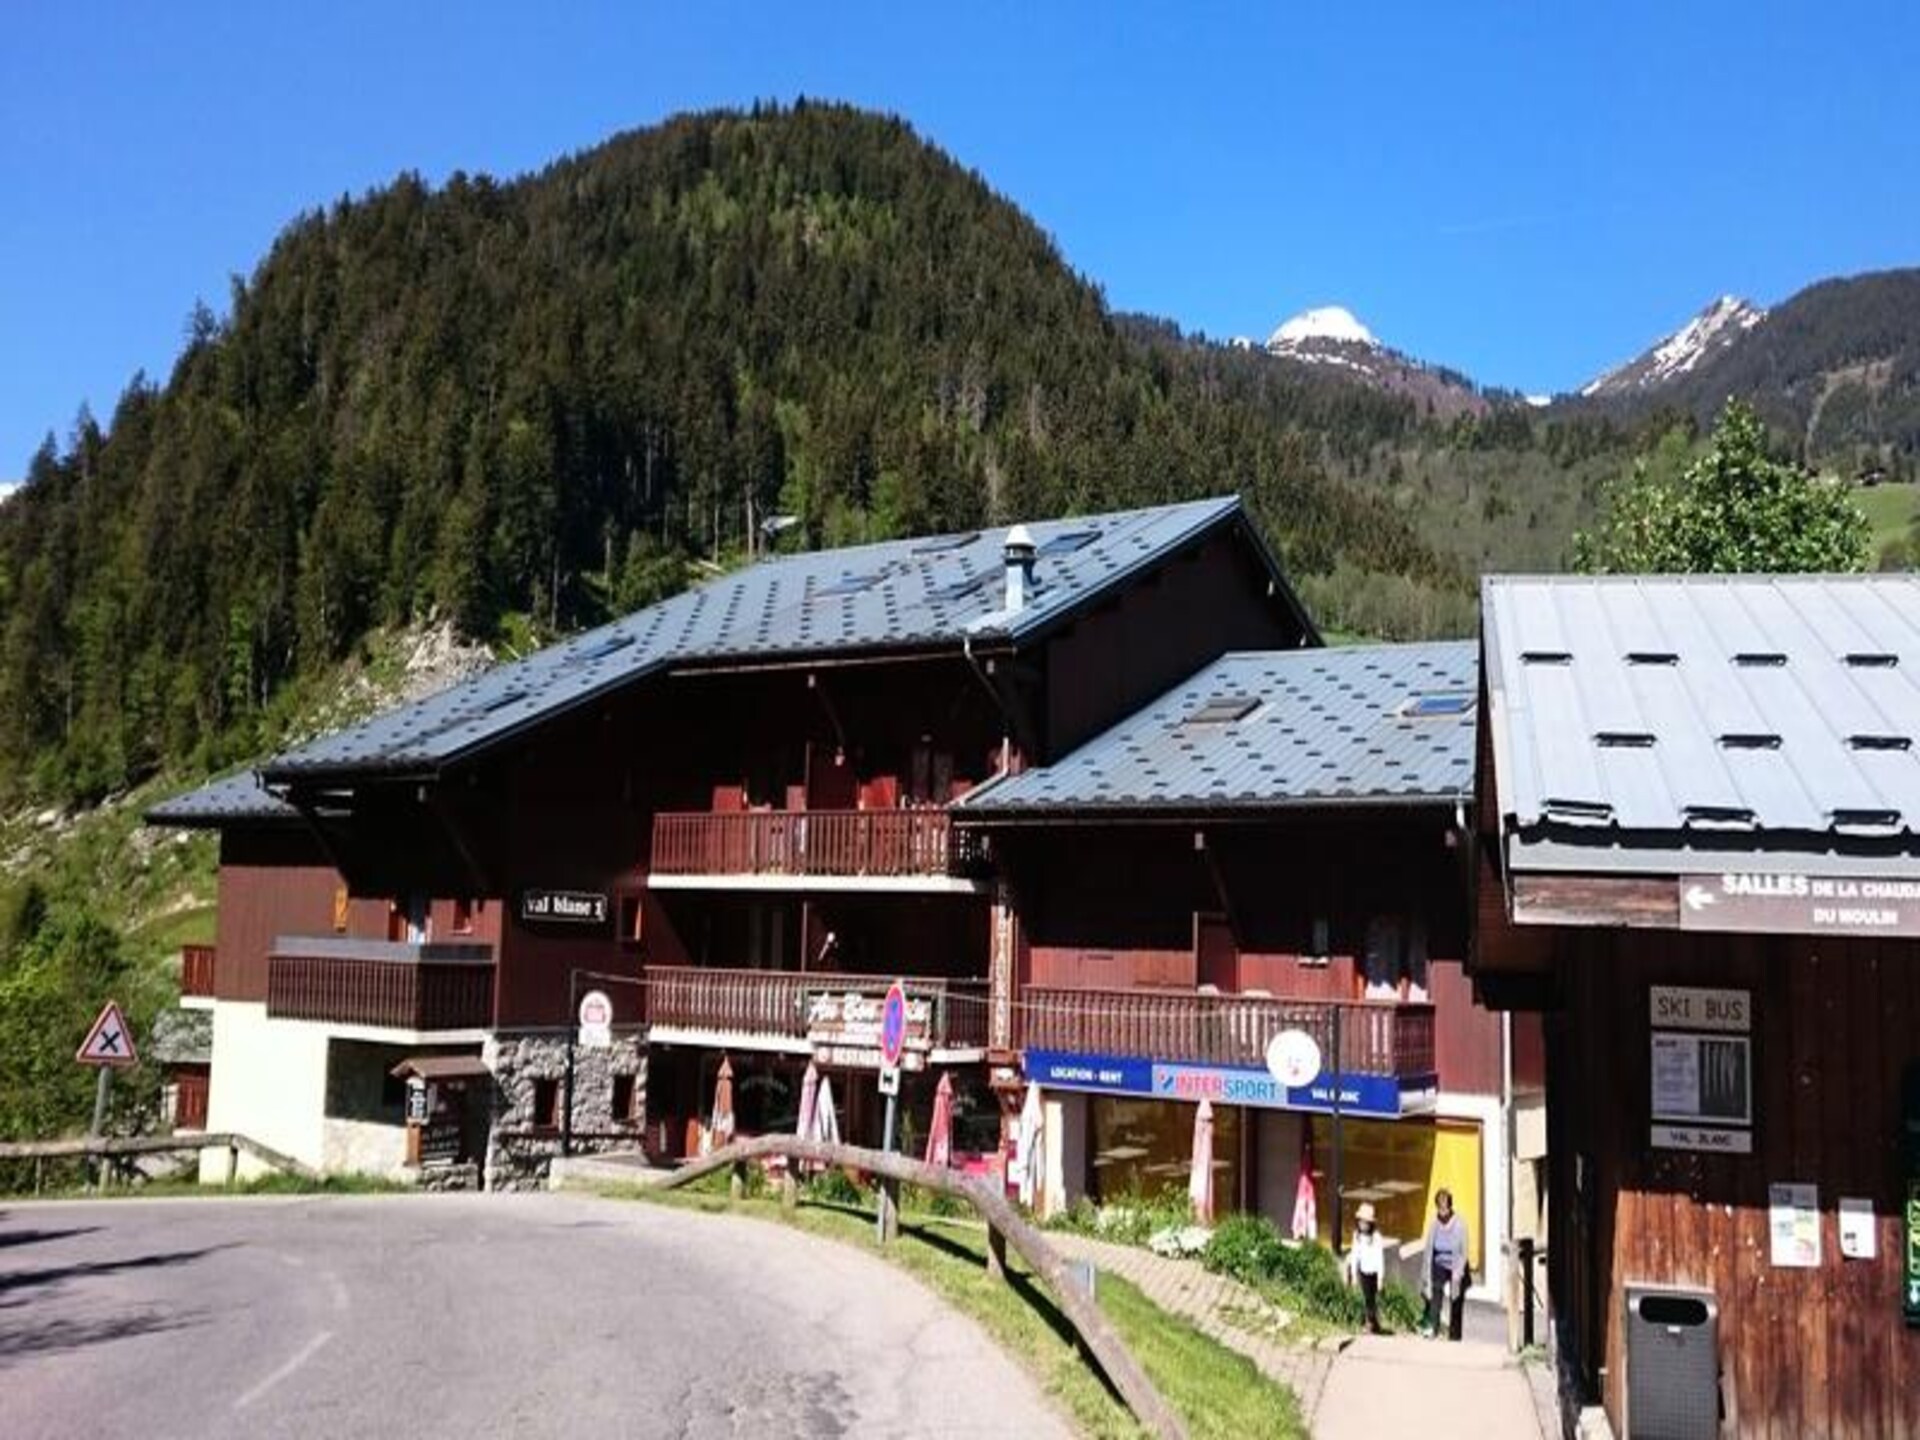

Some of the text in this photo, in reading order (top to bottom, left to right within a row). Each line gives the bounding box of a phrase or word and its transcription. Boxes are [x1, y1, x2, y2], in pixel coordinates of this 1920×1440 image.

[1722, 873, 1808, 895] SALLES
[1812, 881, 1834, 896] DE
[1838, 883, 1858, 897] LA
[527, 896, 549, 913] val
[1814, 908, 1898, 924] DU MOULIN
[1658, 996, 1743, 1021] SKI BUS
[1051, 1066, 1093, 1081] LOCATION
[1099, 1069, 1123, 1084] RENT
[1176, 1070, 1276, 1099] INTERSPORT
